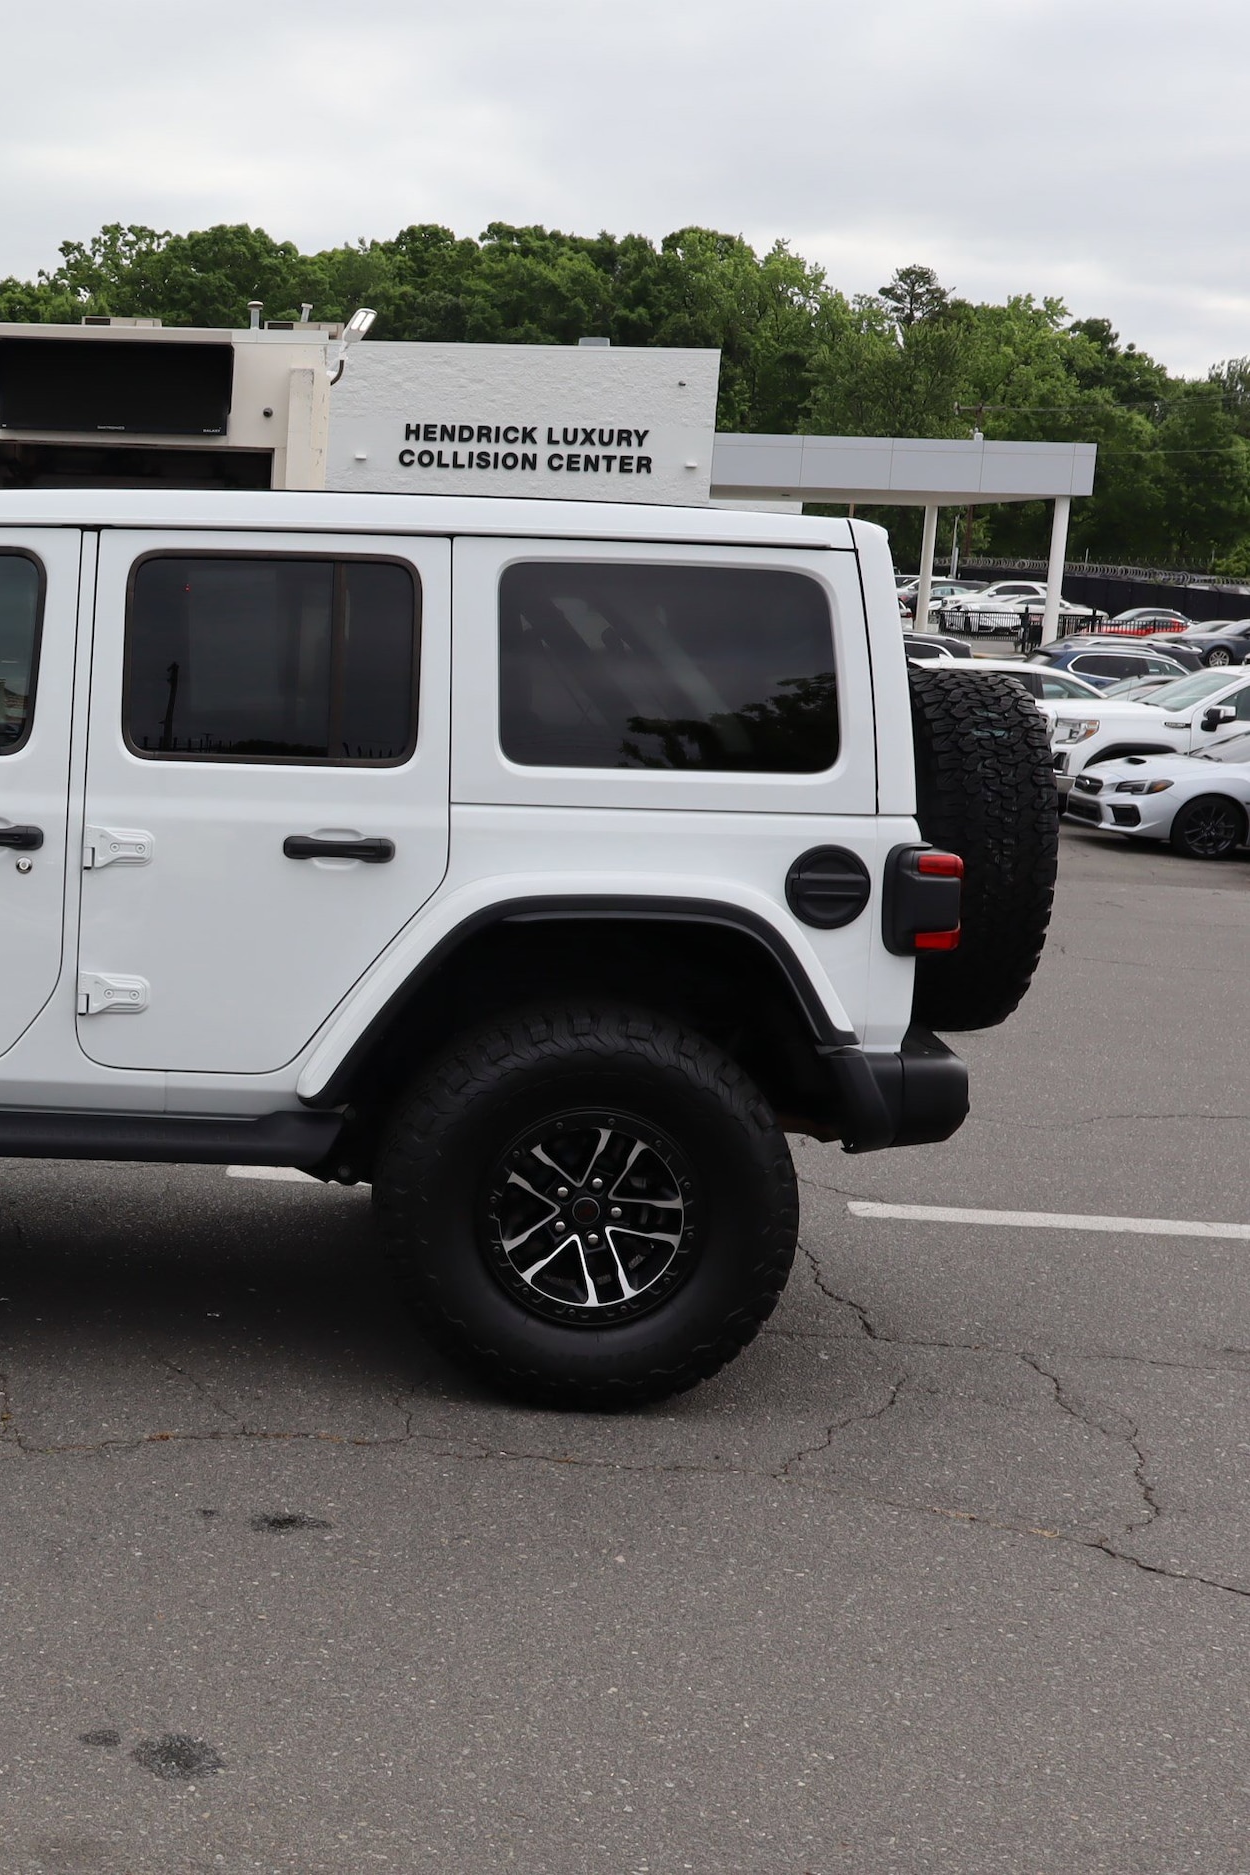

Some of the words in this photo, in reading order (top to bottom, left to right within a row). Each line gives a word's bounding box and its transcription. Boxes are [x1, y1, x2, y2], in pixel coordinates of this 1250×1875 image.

[405, 423, 538, 445] HENDRICK
[547, 427, 650, 447] LUXURY
[398, 449, 538, 471] COLLISION
[547, 453, 653, 474] CENTER
